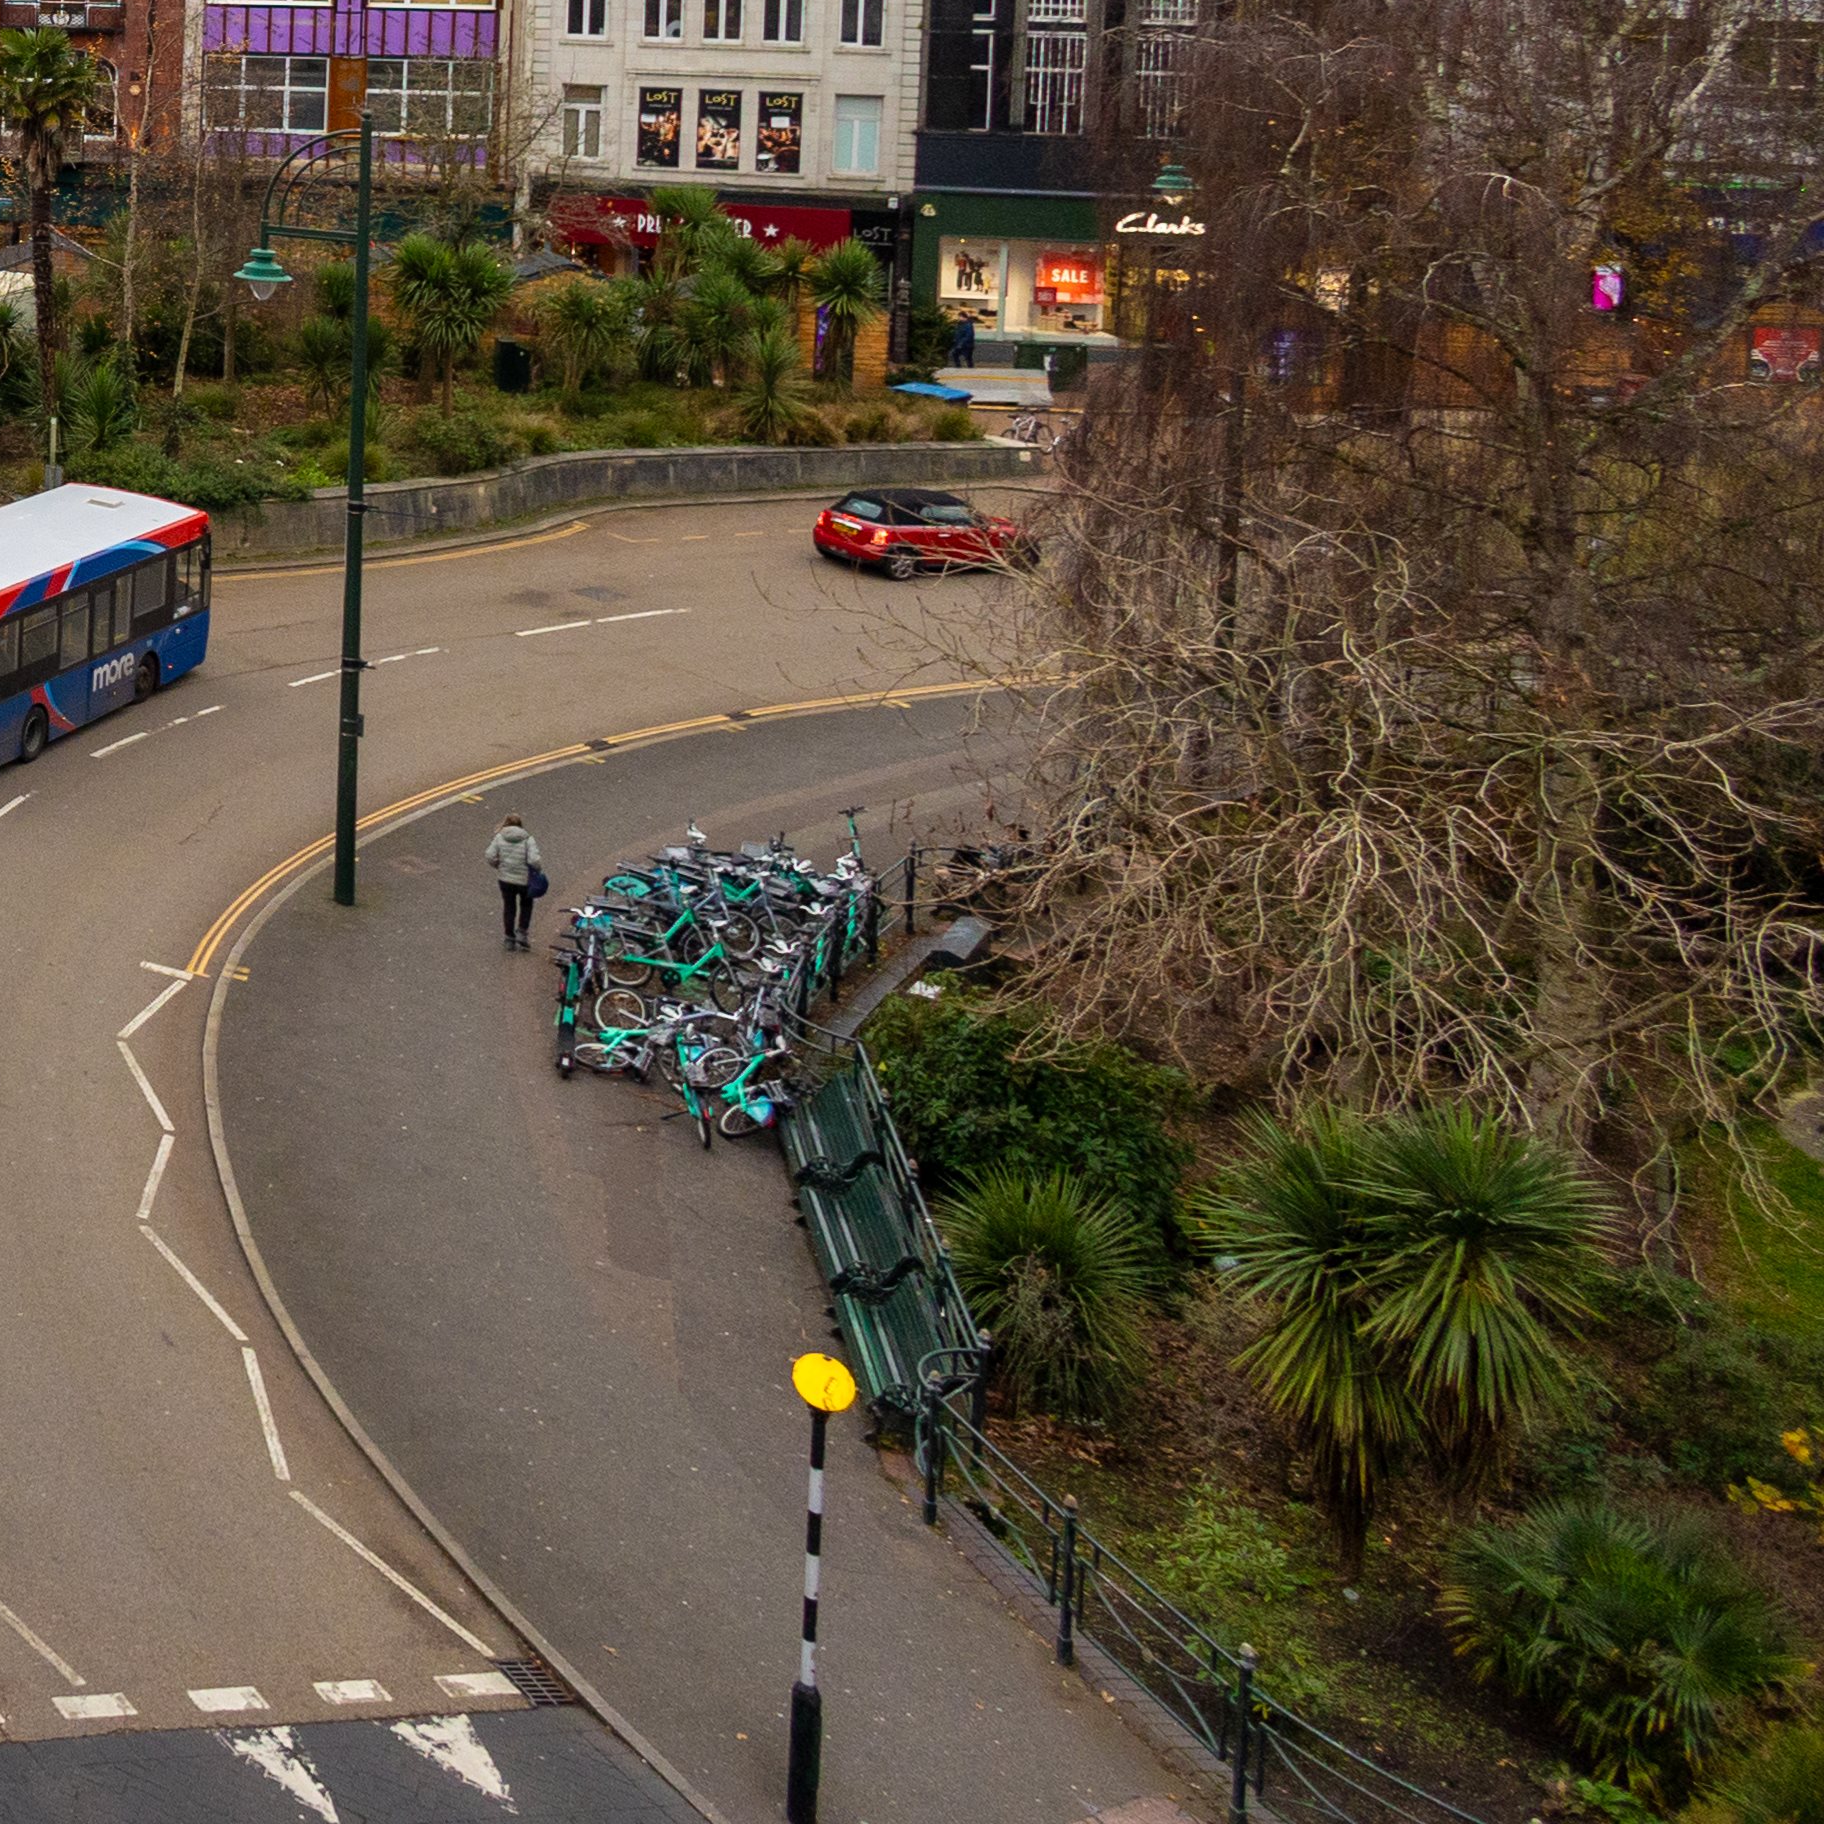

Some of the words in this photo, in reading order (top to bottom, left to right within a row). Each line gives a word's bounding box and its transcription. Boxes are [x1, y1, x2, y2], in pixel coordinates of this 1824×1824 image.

[646, 90, 679, 102] LOST
[705, 93, 738, 107] LOST
[765, 95, 799, 108] LOST
[1115, 211, 1206, 235] Clarks
[853, 226, 893, 242] LOST
[1051, 268, 1089, 284] SALE
[92, 652, 135, 692] more
